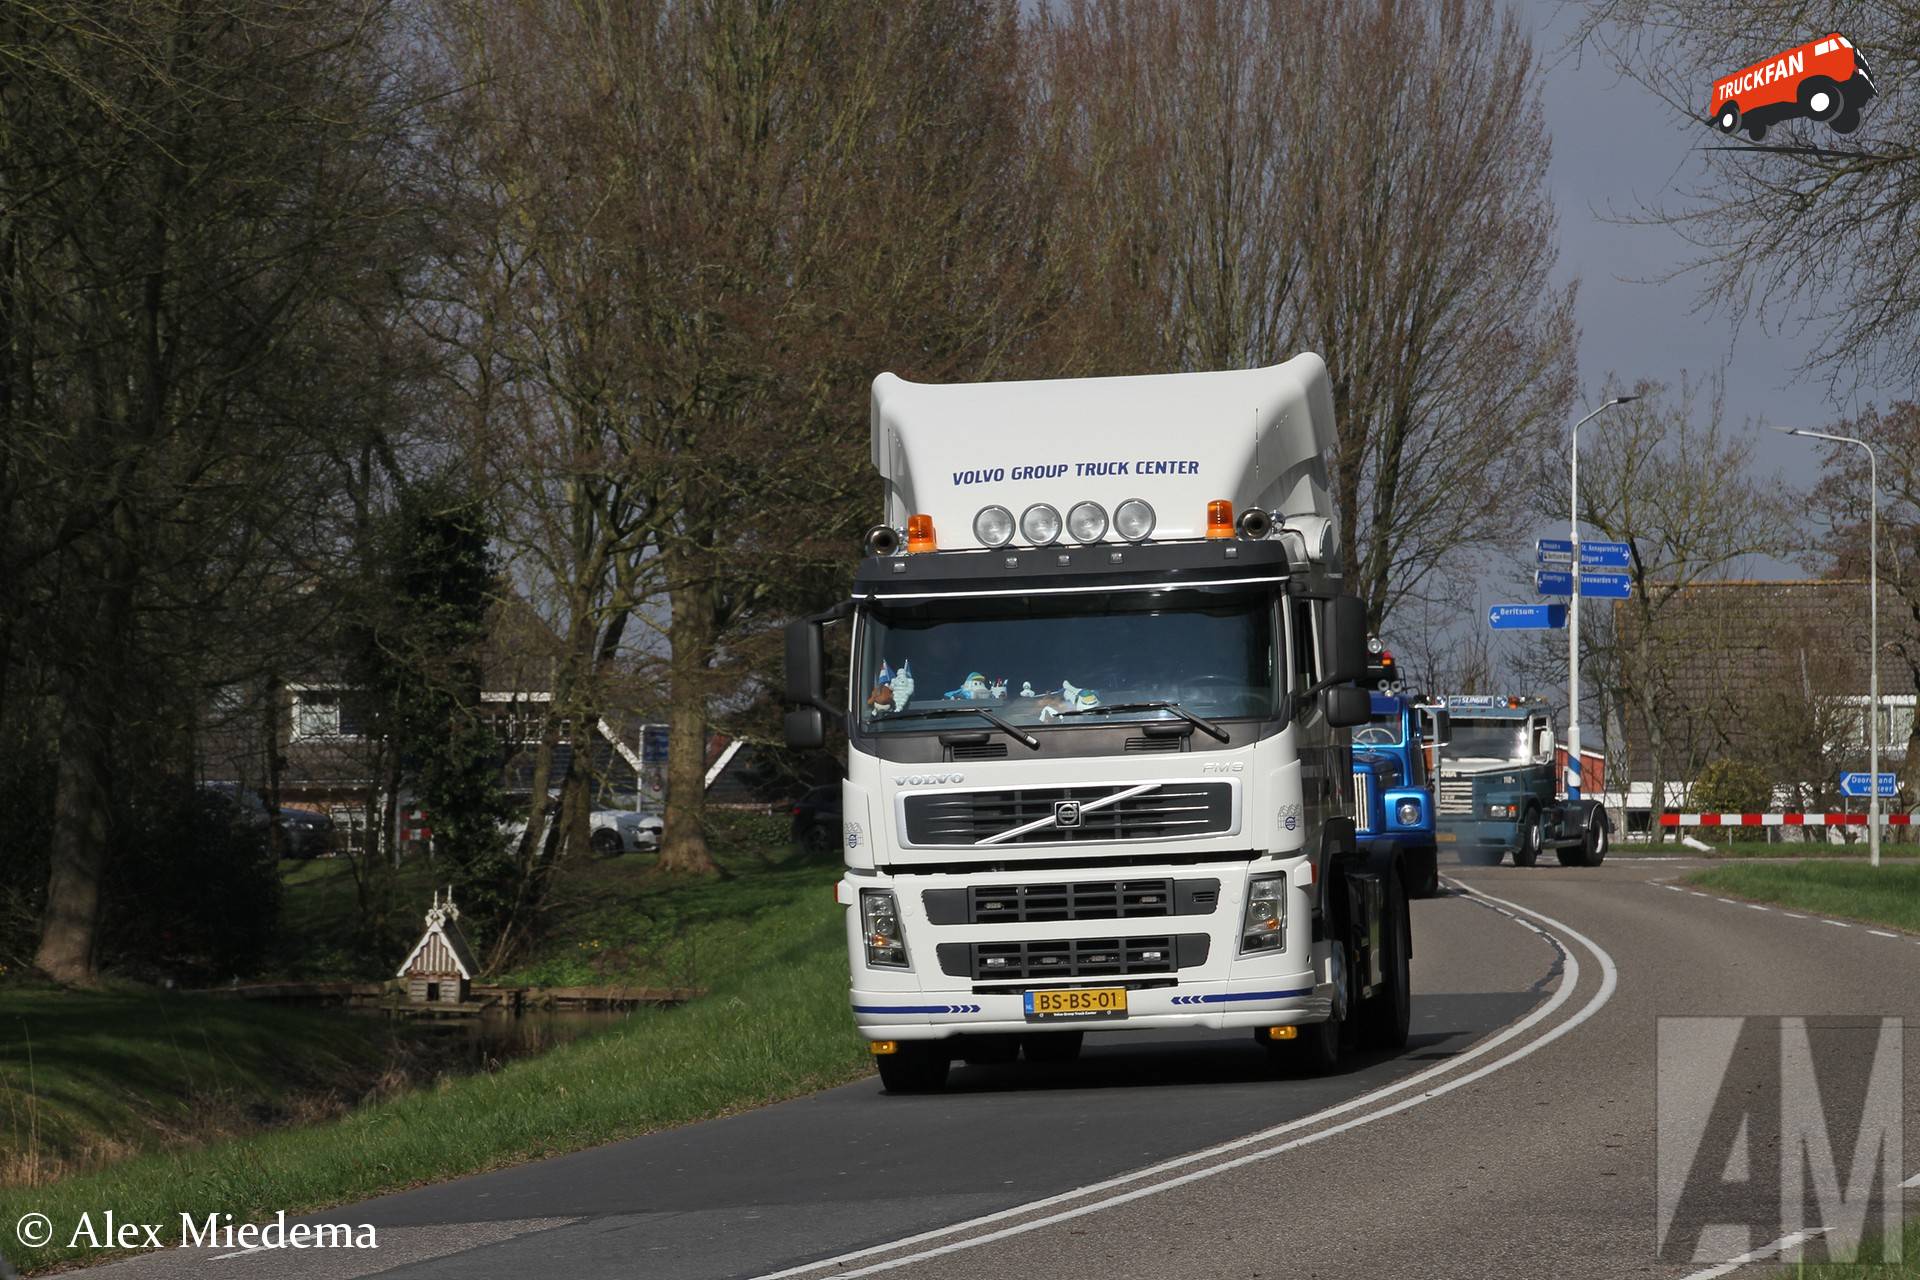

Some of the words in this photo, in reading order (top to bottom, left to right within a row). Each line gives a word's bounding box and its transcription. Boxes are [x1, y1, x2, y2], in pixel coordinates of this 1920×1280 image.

[952, 467, 1005, 486] VOLVO
[1010, 464, 1069, 481] GROUP
[1075, 461, 1129, 477] TRUCK
[1135, 460, 1200, 475] CENTER
[893, 772, 964, 786] VOLVO
[1851, 776, 1893, 784] Doorand
[1040, 992, 1116, 1010] BS-BS-01
